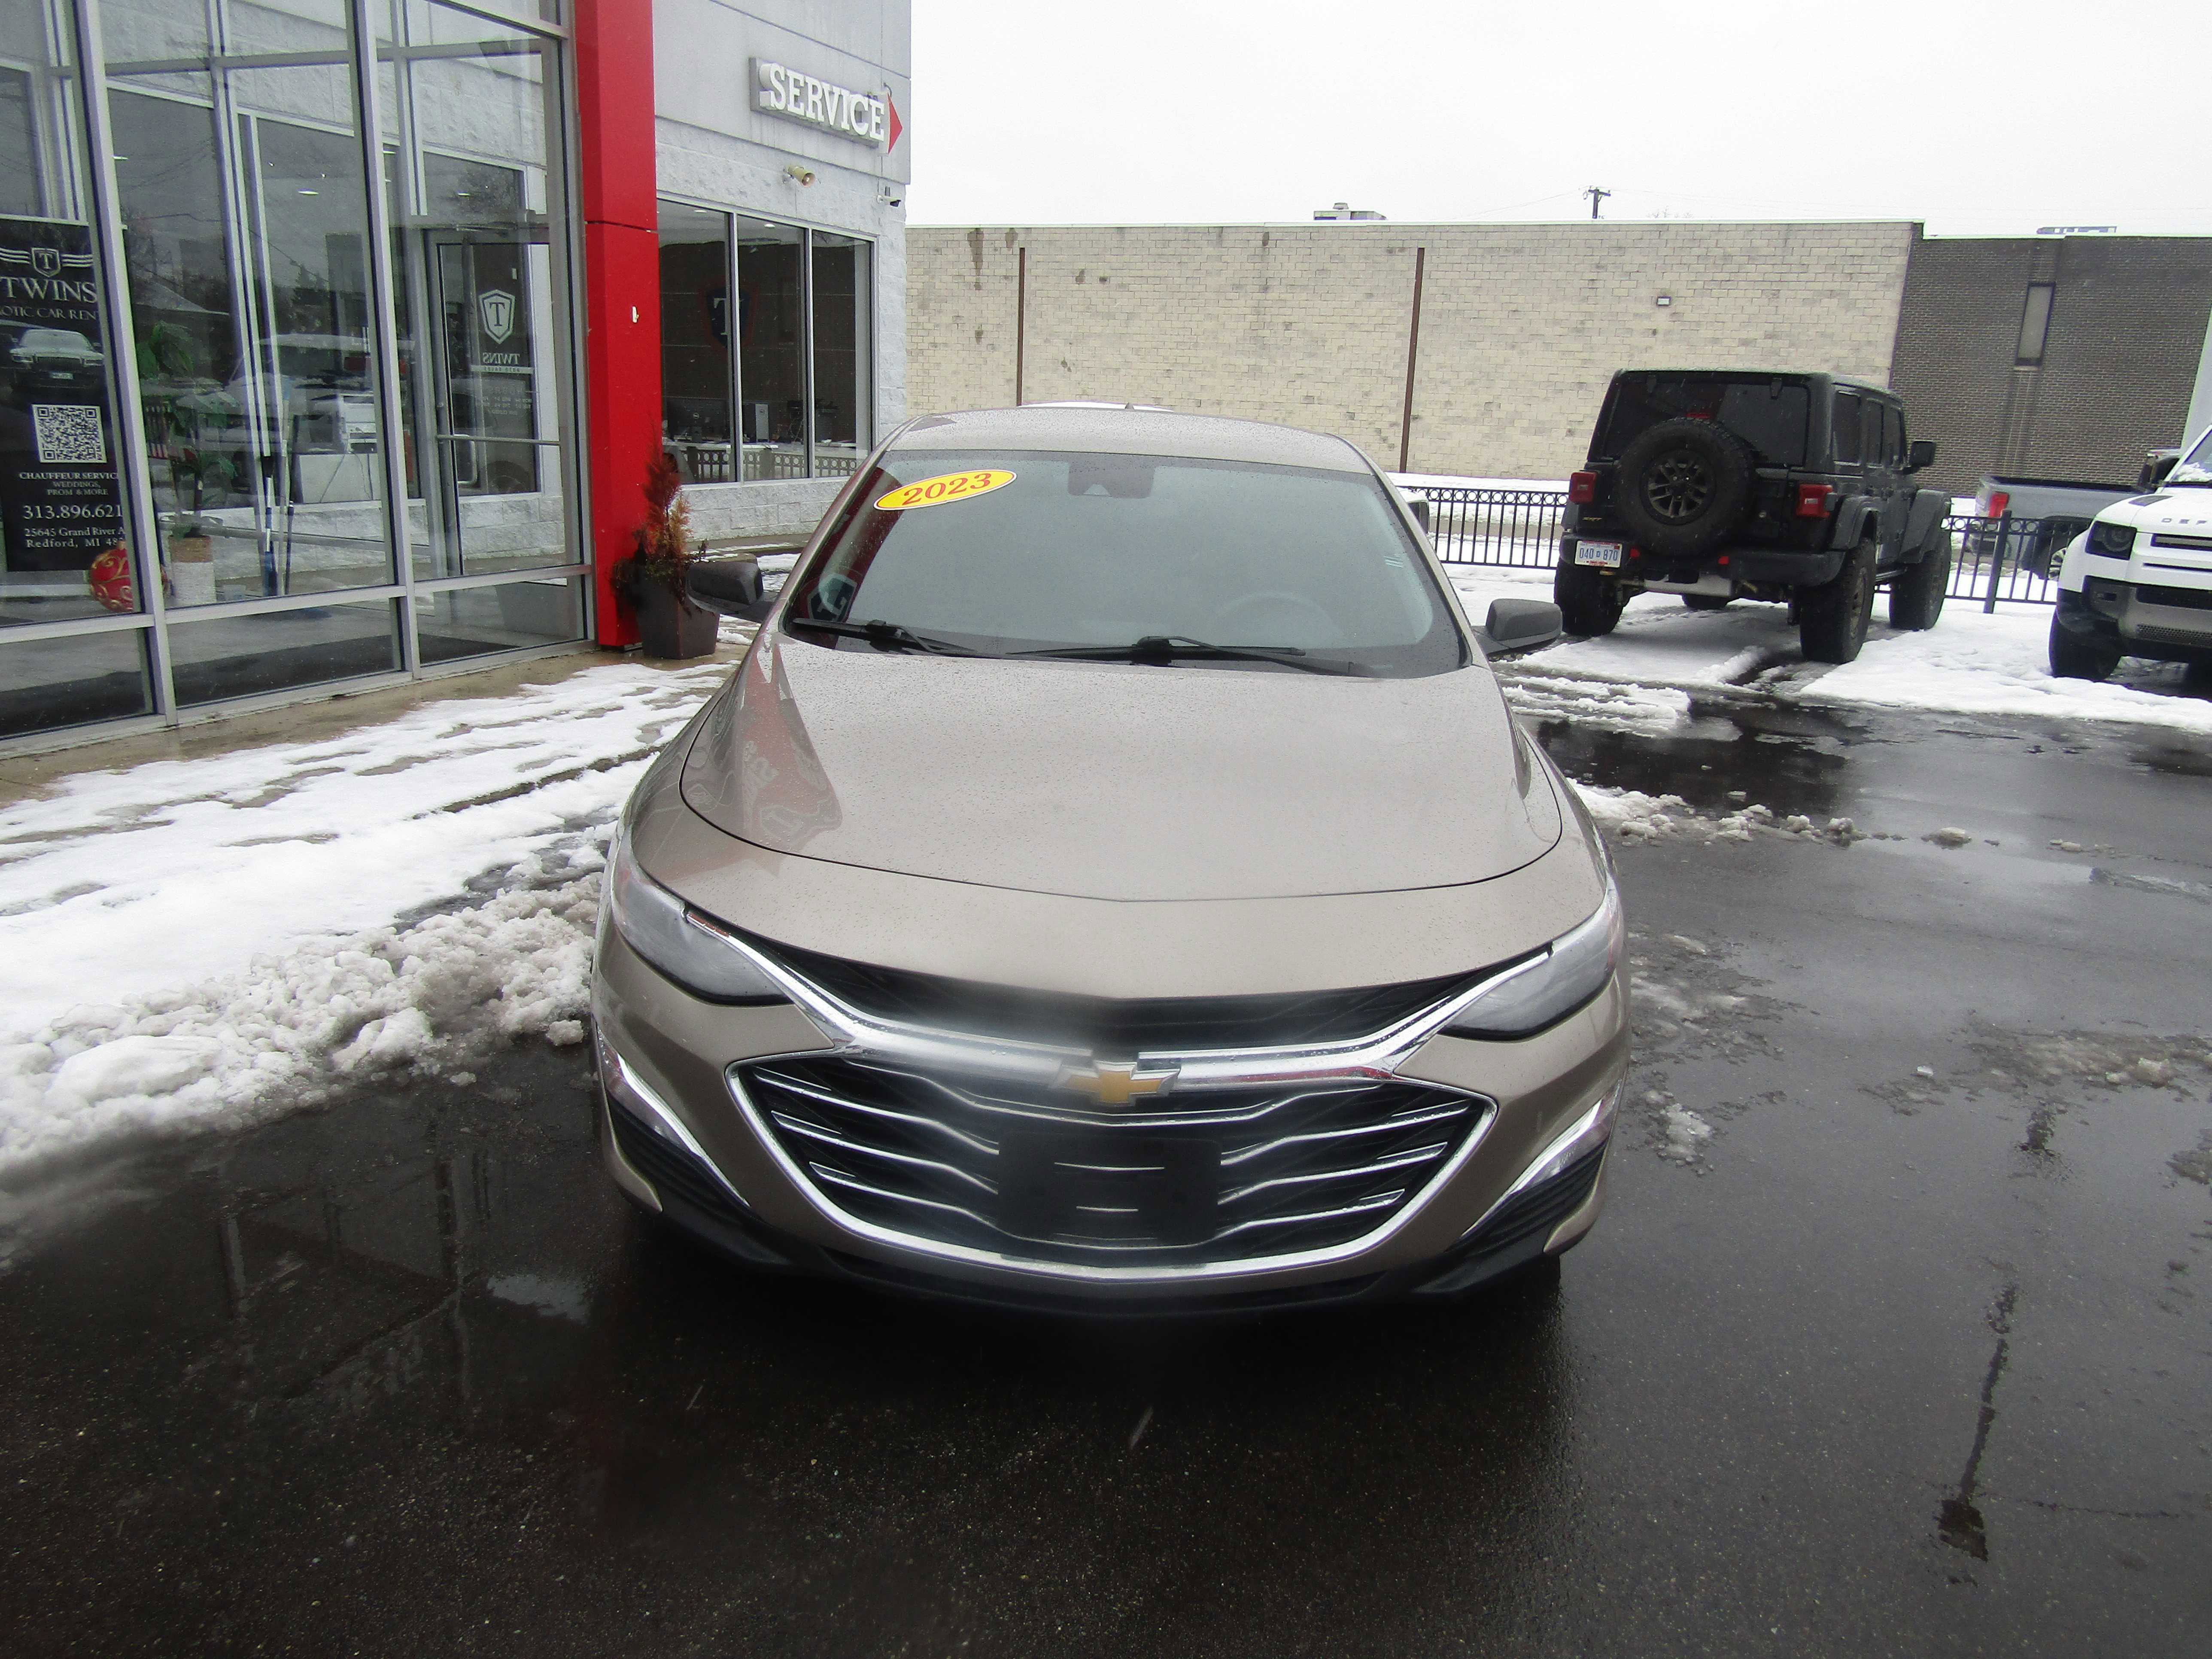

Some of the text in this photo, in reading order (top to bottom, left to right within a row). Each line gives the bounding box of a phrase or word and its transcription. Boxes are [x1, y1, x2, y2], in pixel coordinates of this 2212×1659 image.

[759, 63, 884, 141] SERVICE
[0, 276, 98, 303] TWINS
[37, 308, 66, 319] CAR
[902, 473, 991, 505] 2023
[24, 528, 57, 537] 25645
[59, 527, 90, 536] Grand
[92, 527, 116, 535] River
[26, 537, 124, 548] Redford, MI 48
